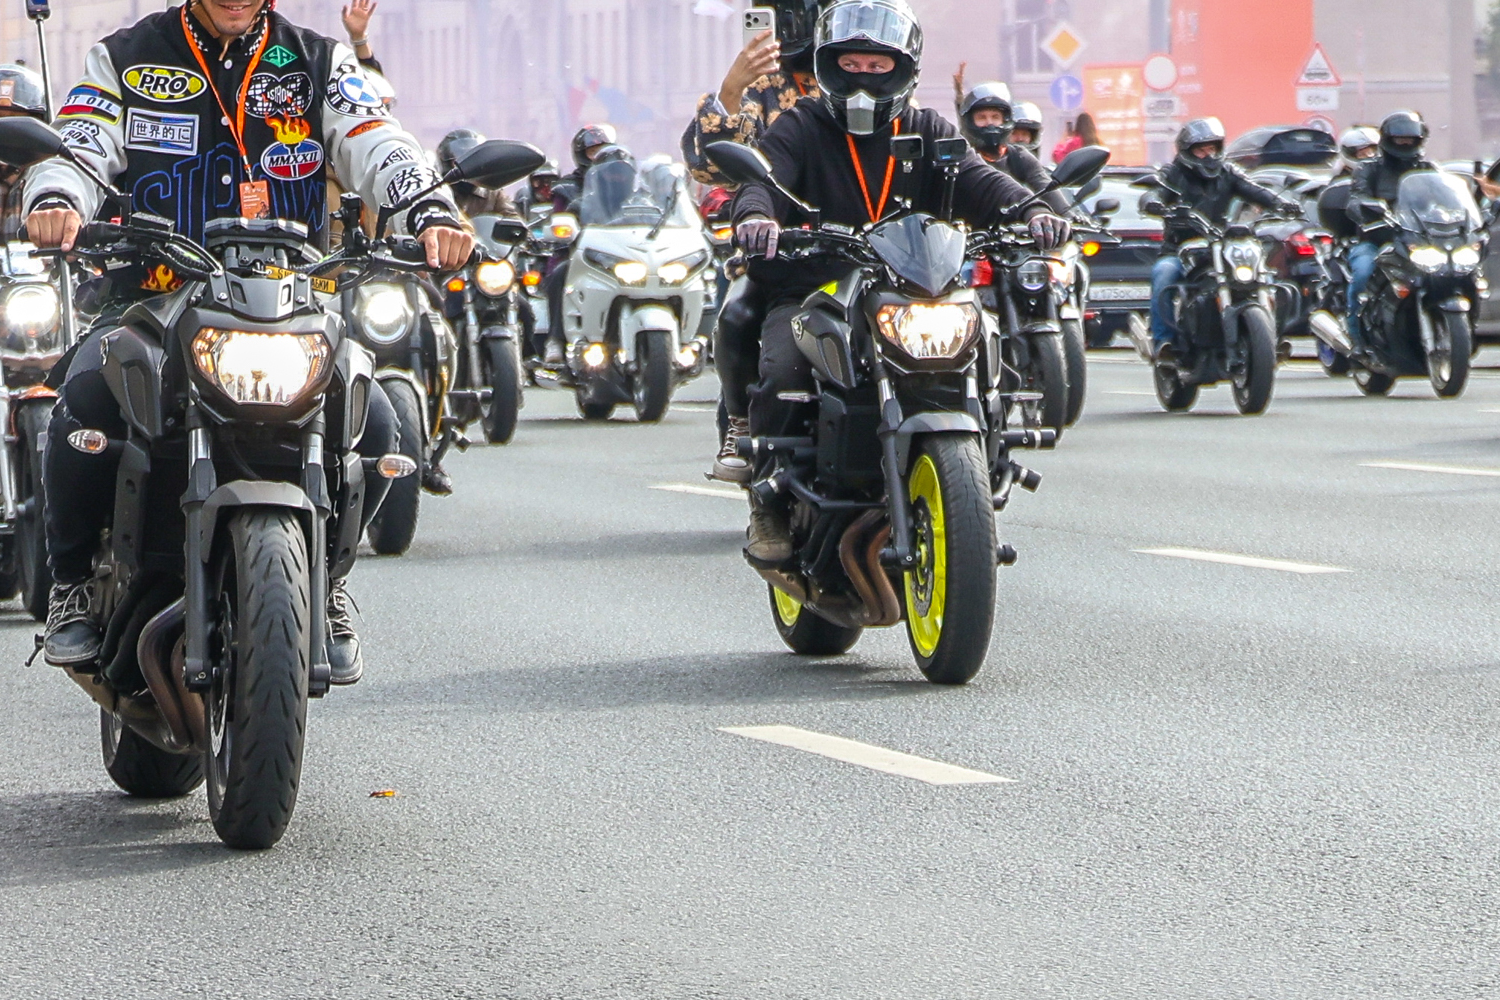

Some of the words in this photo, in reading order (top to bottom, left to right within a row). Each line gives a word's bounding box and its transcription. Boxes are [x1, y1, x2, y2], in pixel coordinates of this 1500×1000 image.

[137, 73, 189, 95] PRO
[86, 96, 113, 113] OIL
[136, 122, 190, 140] 世界的に
[269, 151, 318, 167] MMXXII
